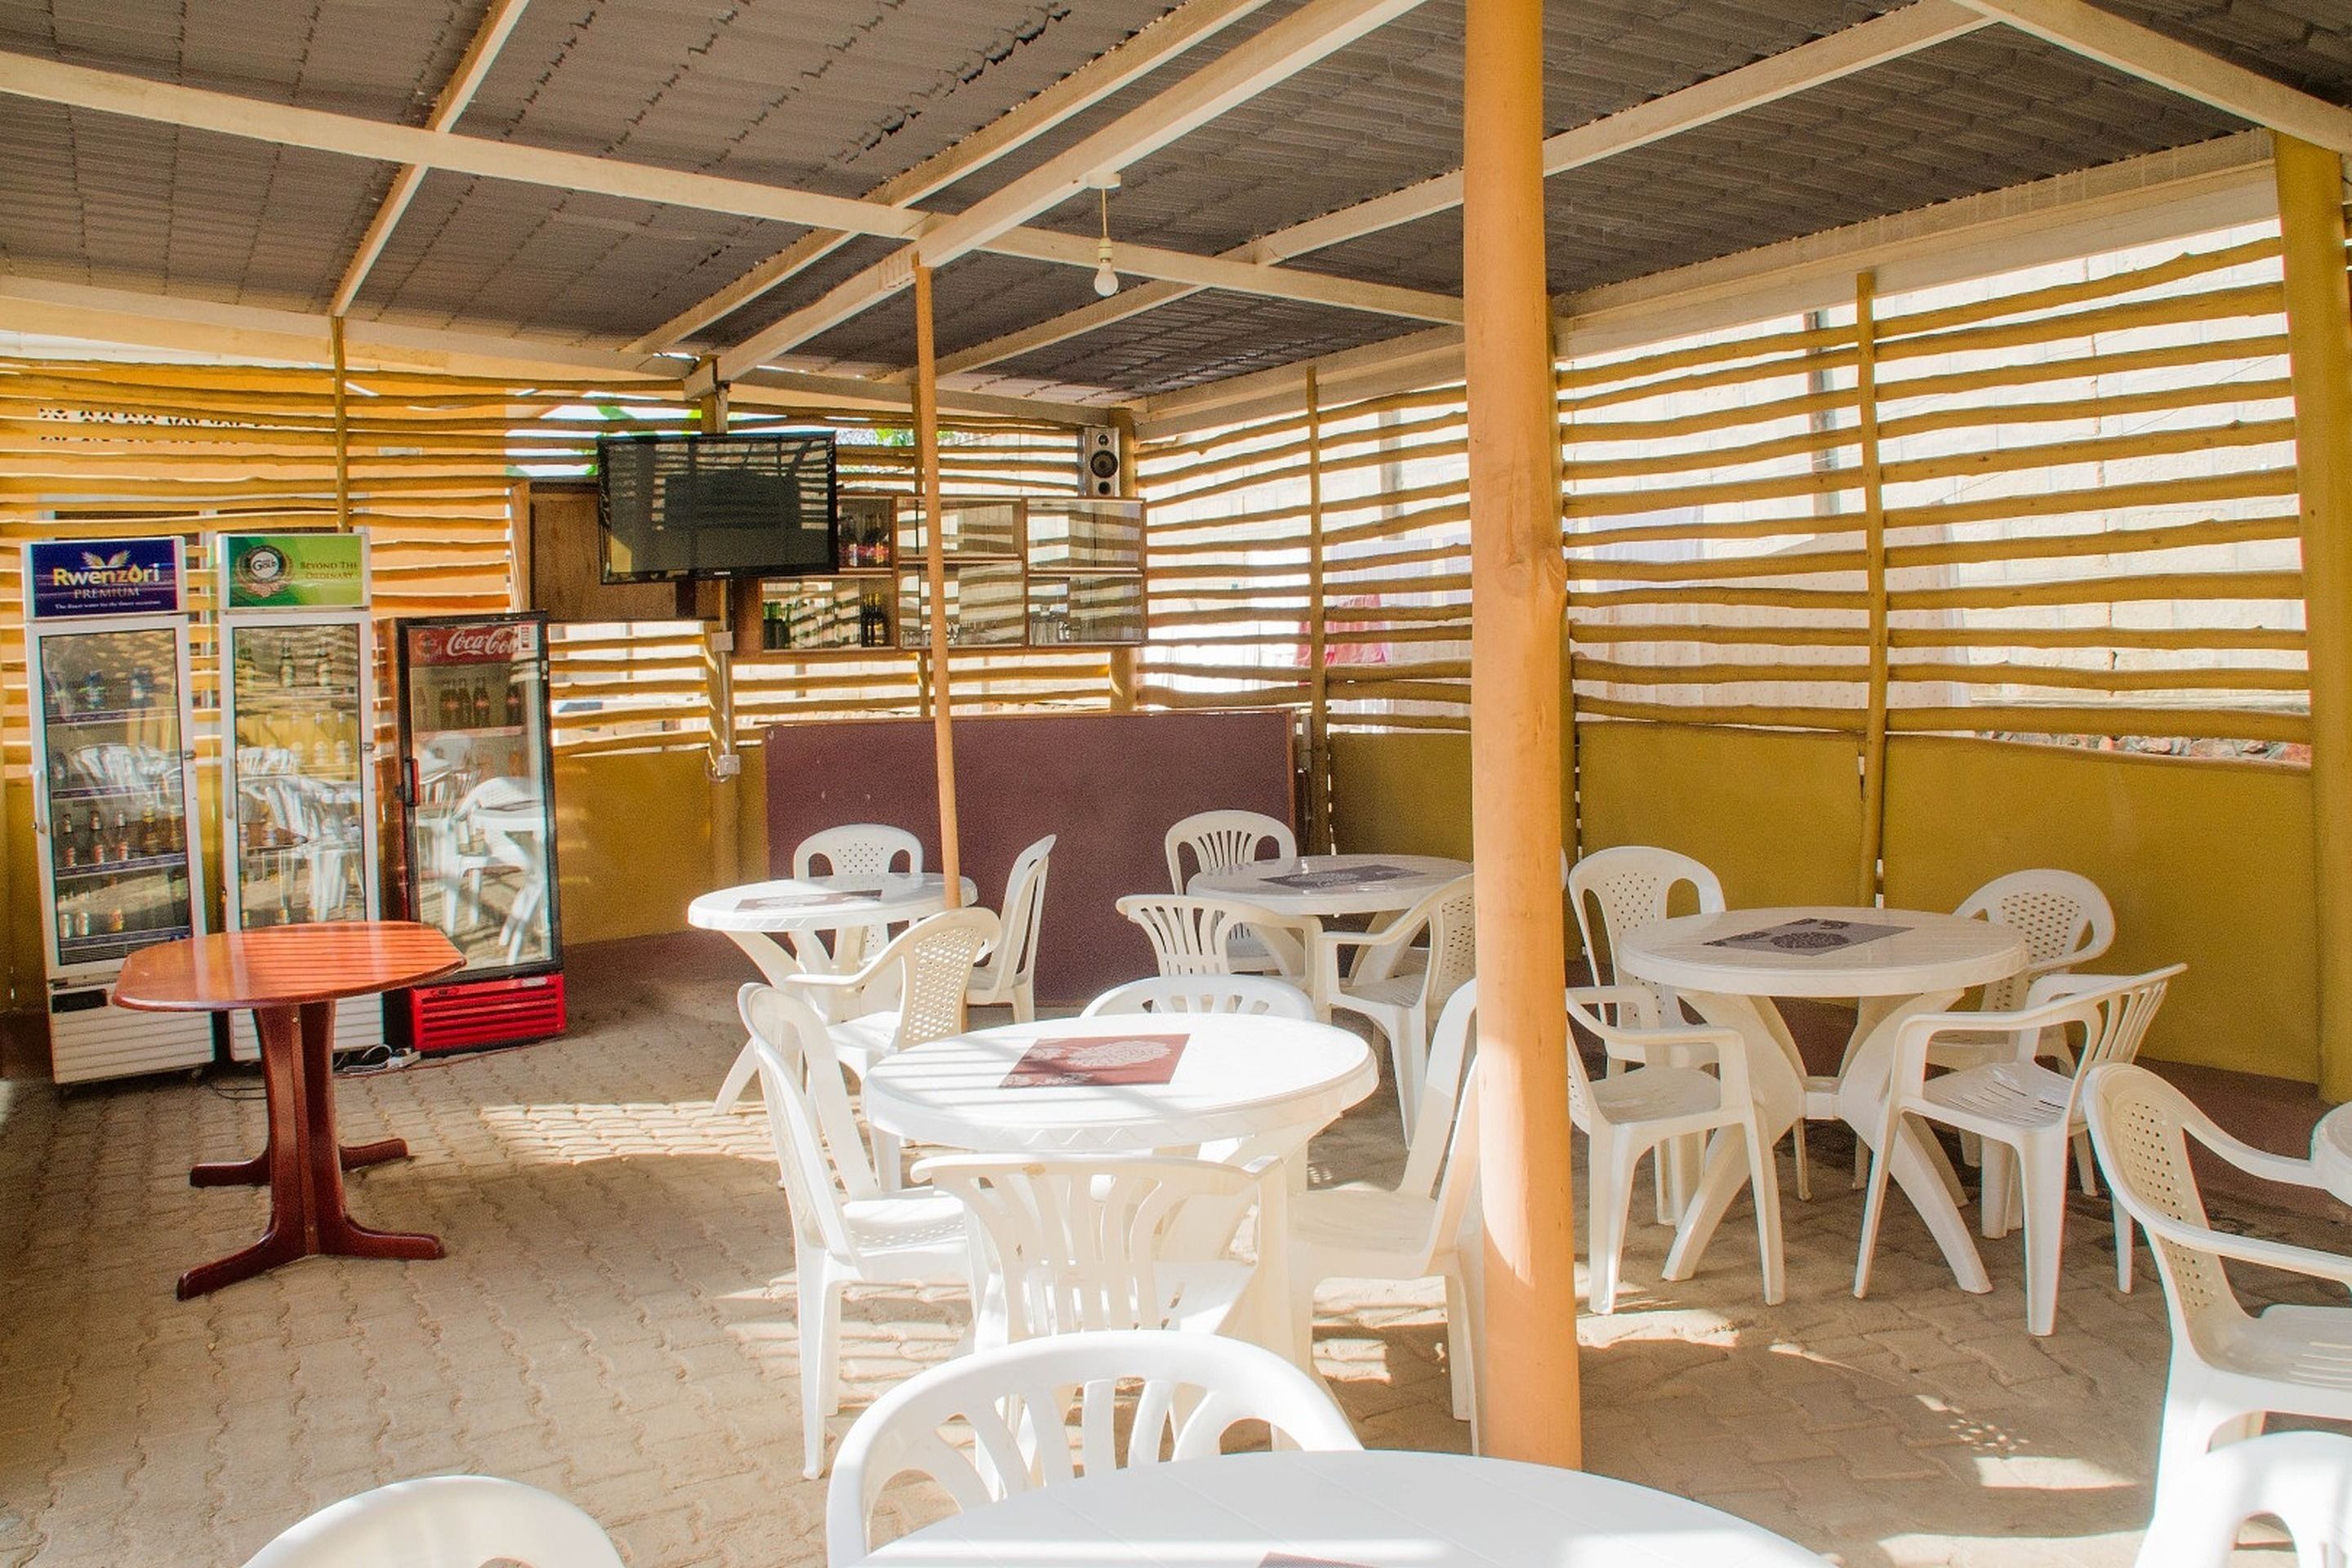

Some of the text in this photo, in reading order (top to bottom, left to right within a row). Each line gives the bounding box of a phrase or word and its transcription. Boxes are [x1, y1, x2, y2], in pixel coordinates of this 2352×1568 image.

[338, 561, 358, 569] THE
[52, 563, 160, 586] Rwenzori
[74, 587, 140, 599] PREMIUM
